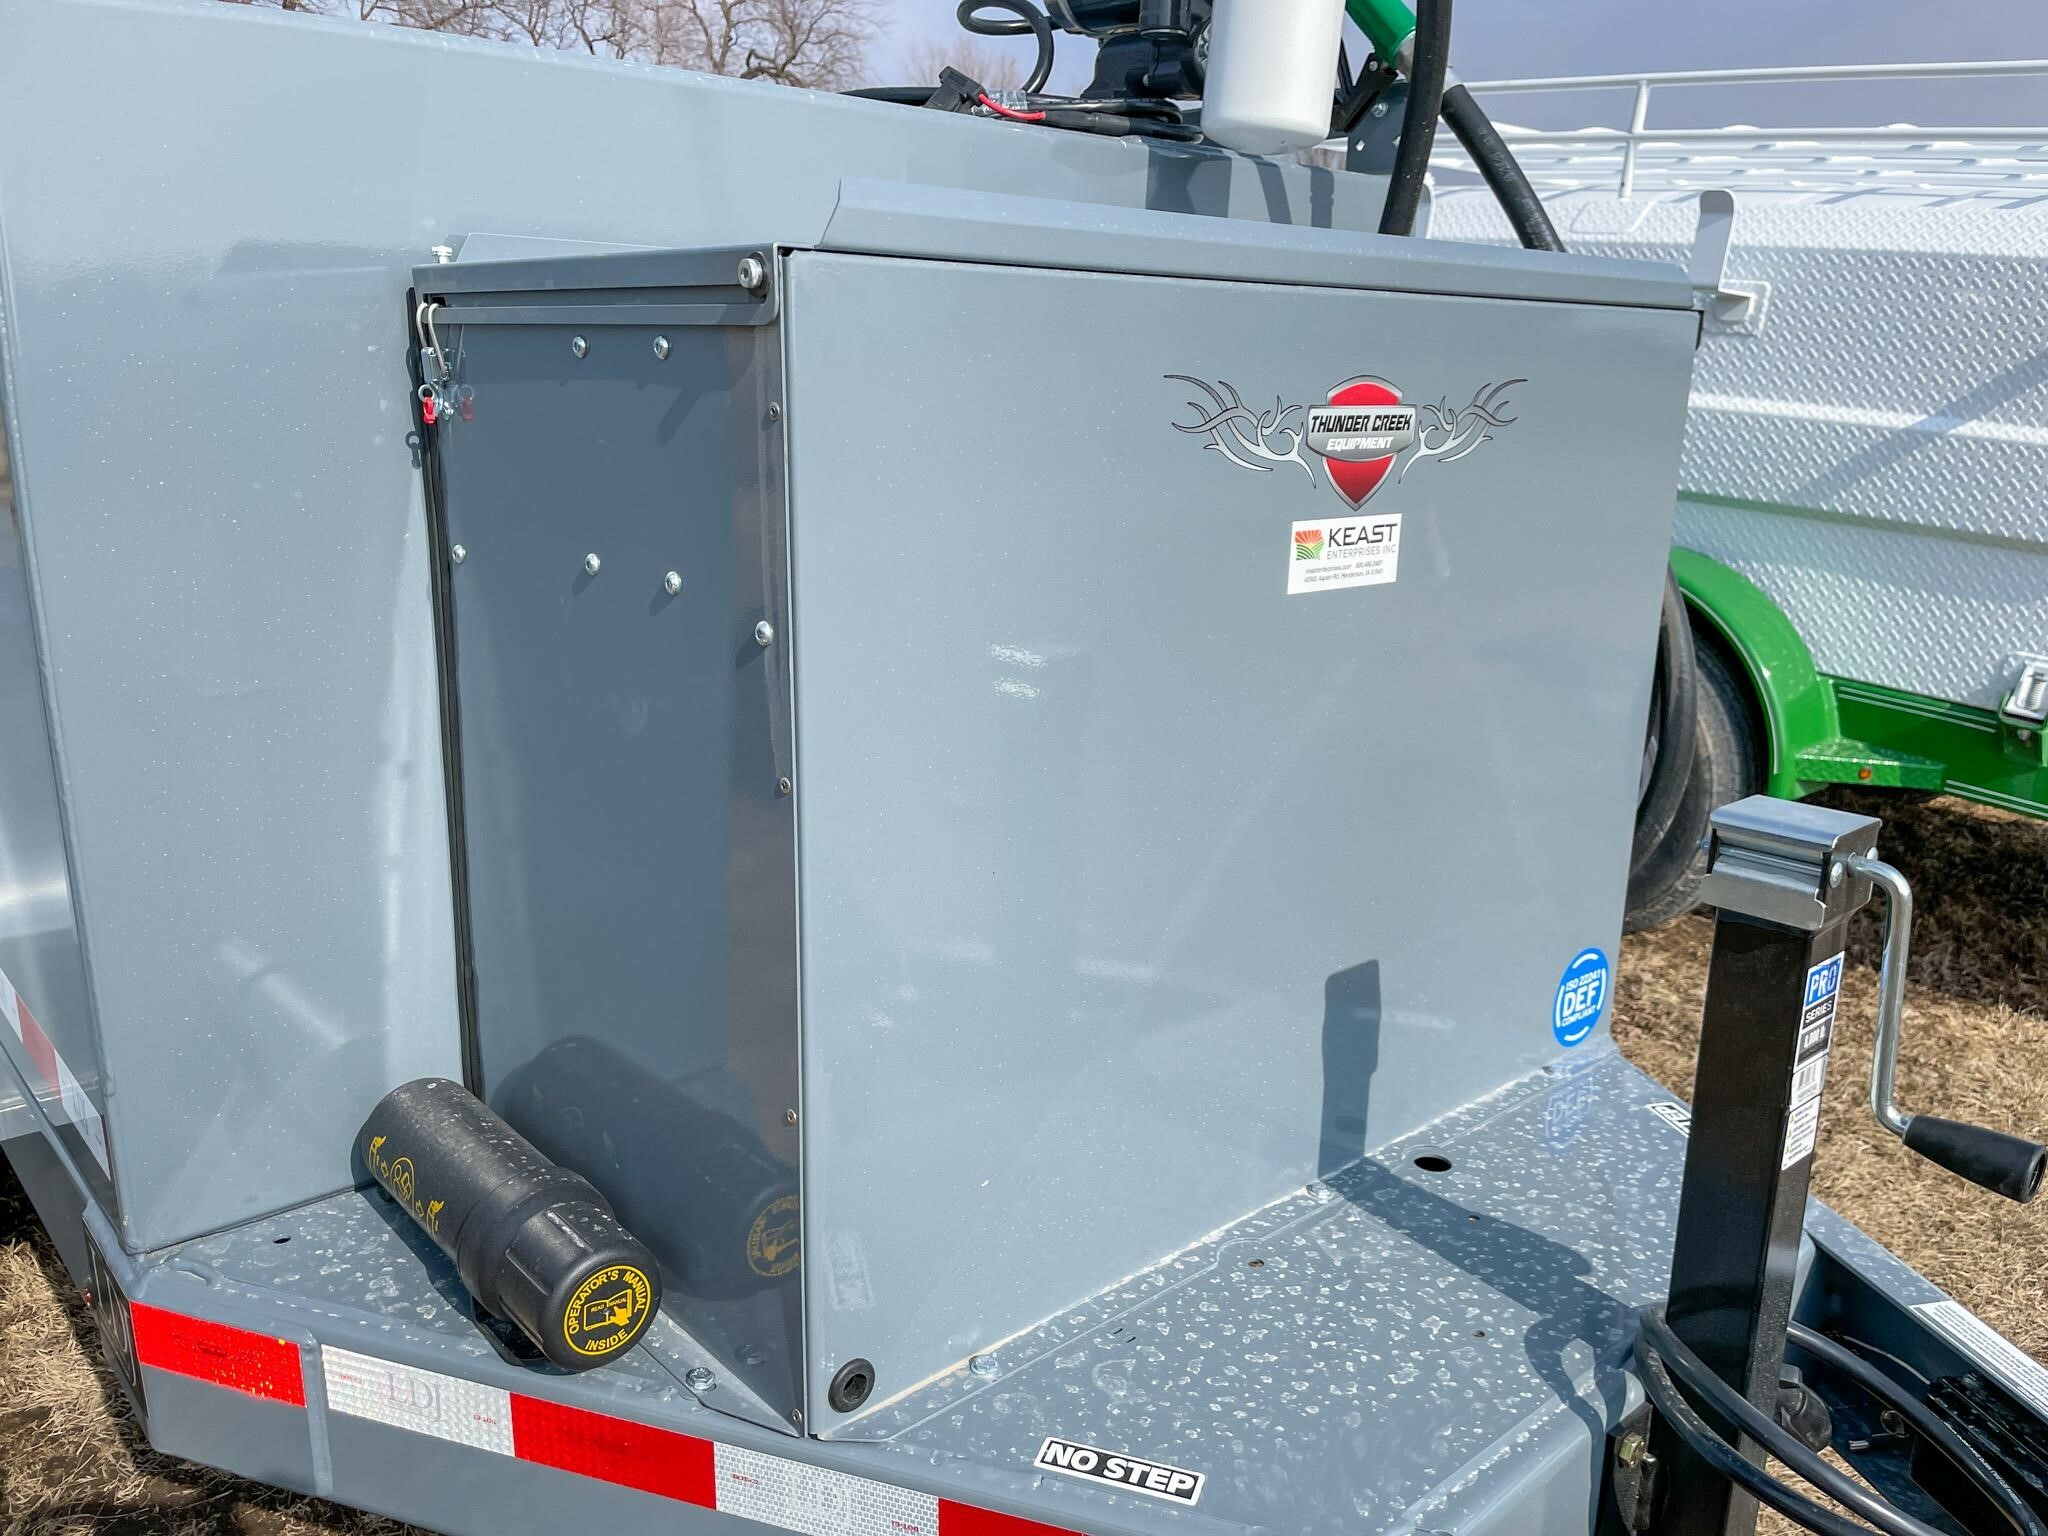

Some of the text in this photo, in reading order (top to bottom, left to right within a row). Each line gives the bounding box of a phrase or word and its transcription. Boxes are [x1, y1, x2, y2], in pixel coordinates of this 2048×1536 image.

[1310, 414, 1413, 433] THUNDER CREEK
[1326, 437, 1394, 452] EQUIPMENT
[1328, 523, 1398, 548] KEAST
[1327, 543, 1397, 560] ENTERPRISES INC
[1565, 977, 1579, 992] ISO
[1808, 964, 1837, 1002] PRO
[1562, 980, 1600, 1018] DEF
[1561, 1004, 1597, 1027] COMPLIANT
[1805, 1000, 1832, 1024] SERIES
[569, 1269, 647, 1335] OPERATOR'S MANUAL
[584, 1328, 628, 1351] INSIDE
[1043, 1442, 1196, 1494] NO STEP
